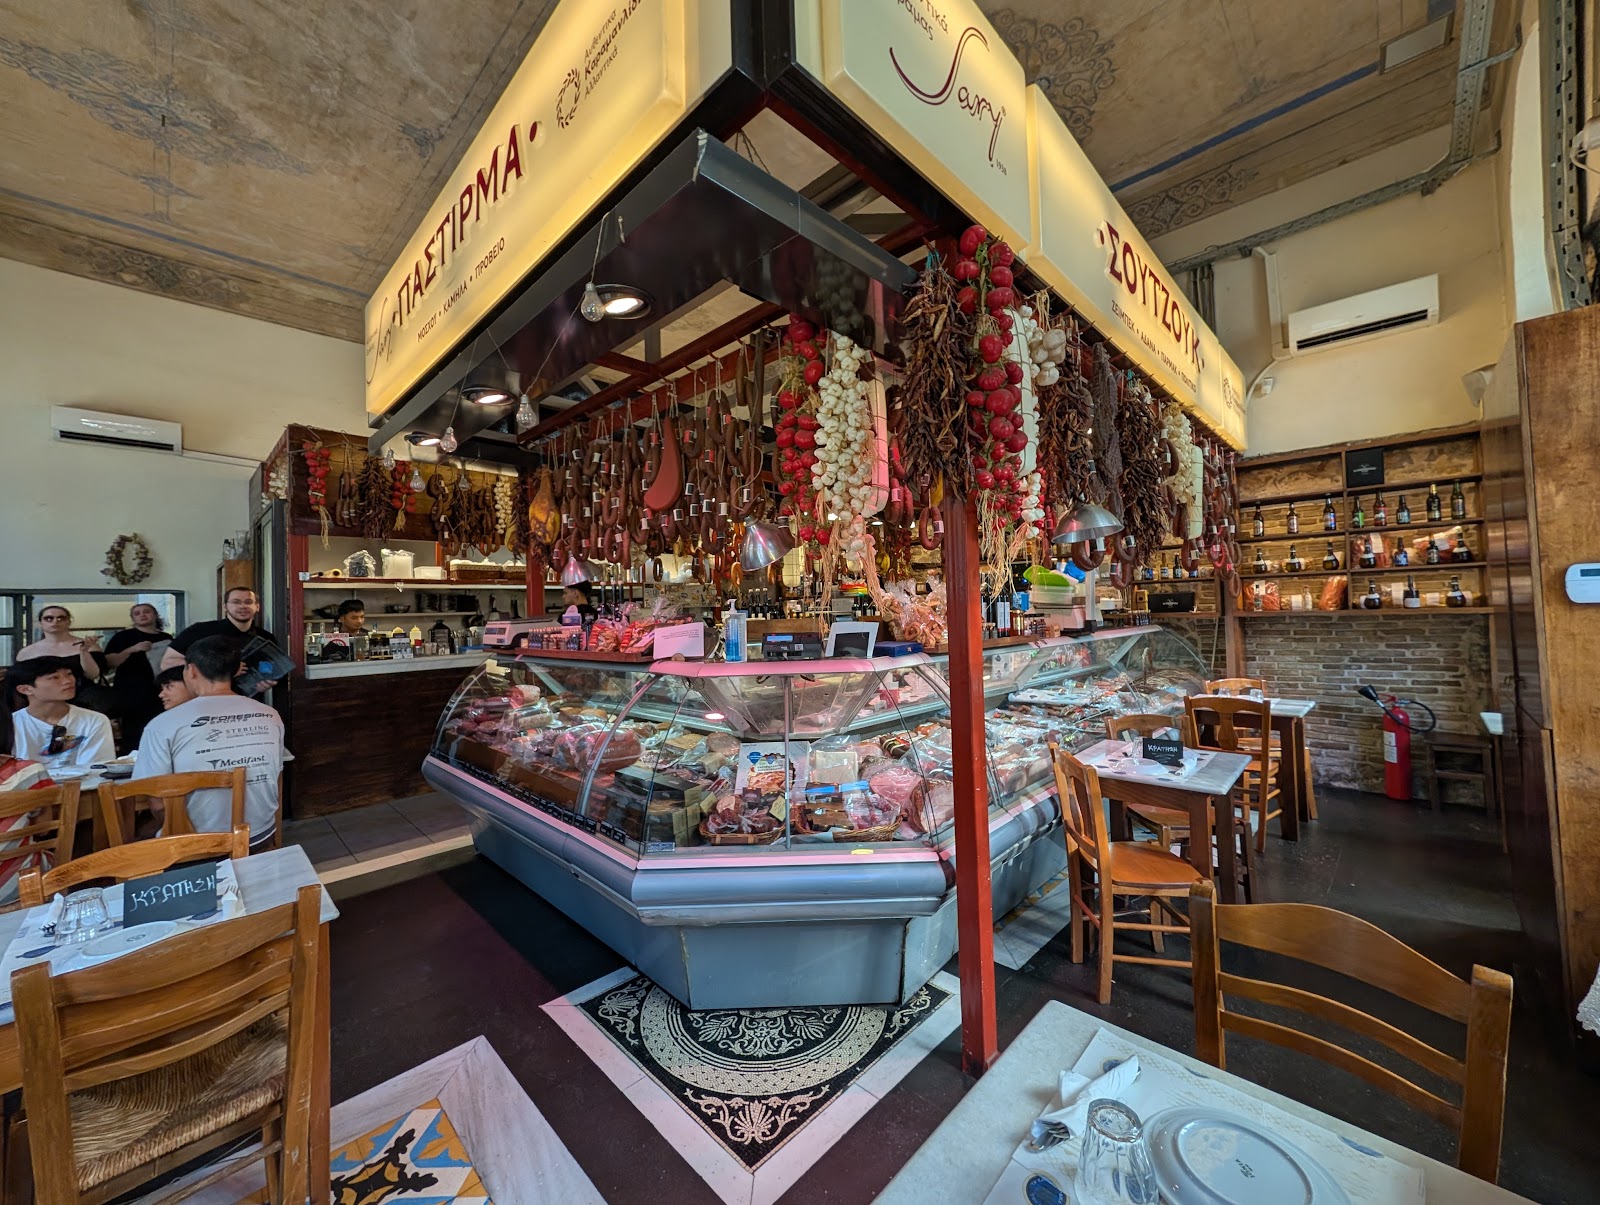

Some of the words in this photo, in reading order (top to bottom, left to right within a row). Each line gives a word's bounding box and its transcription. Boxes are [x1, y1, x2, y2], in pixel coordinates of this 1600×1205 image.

[397, 124, 524, 327] ΠΑΣΤΙΡΜΑ
[417, 313, 437, 343] ΜΟΣΧΟΥ
[443, 280, 468, 315] ΚΑΜΗΛΑ
[474, 236, 505, 280] ΠΡΟΒΕΙΟ
[1105, 220, 1201, 375] ΣΟΥΤΖΟΥΚ
[219, 755, 265, 768] Medifast
[225, 725, 269, 734] STERLING
[129, 874, 216, 912] ΚΡΑΤΗΣΗ
